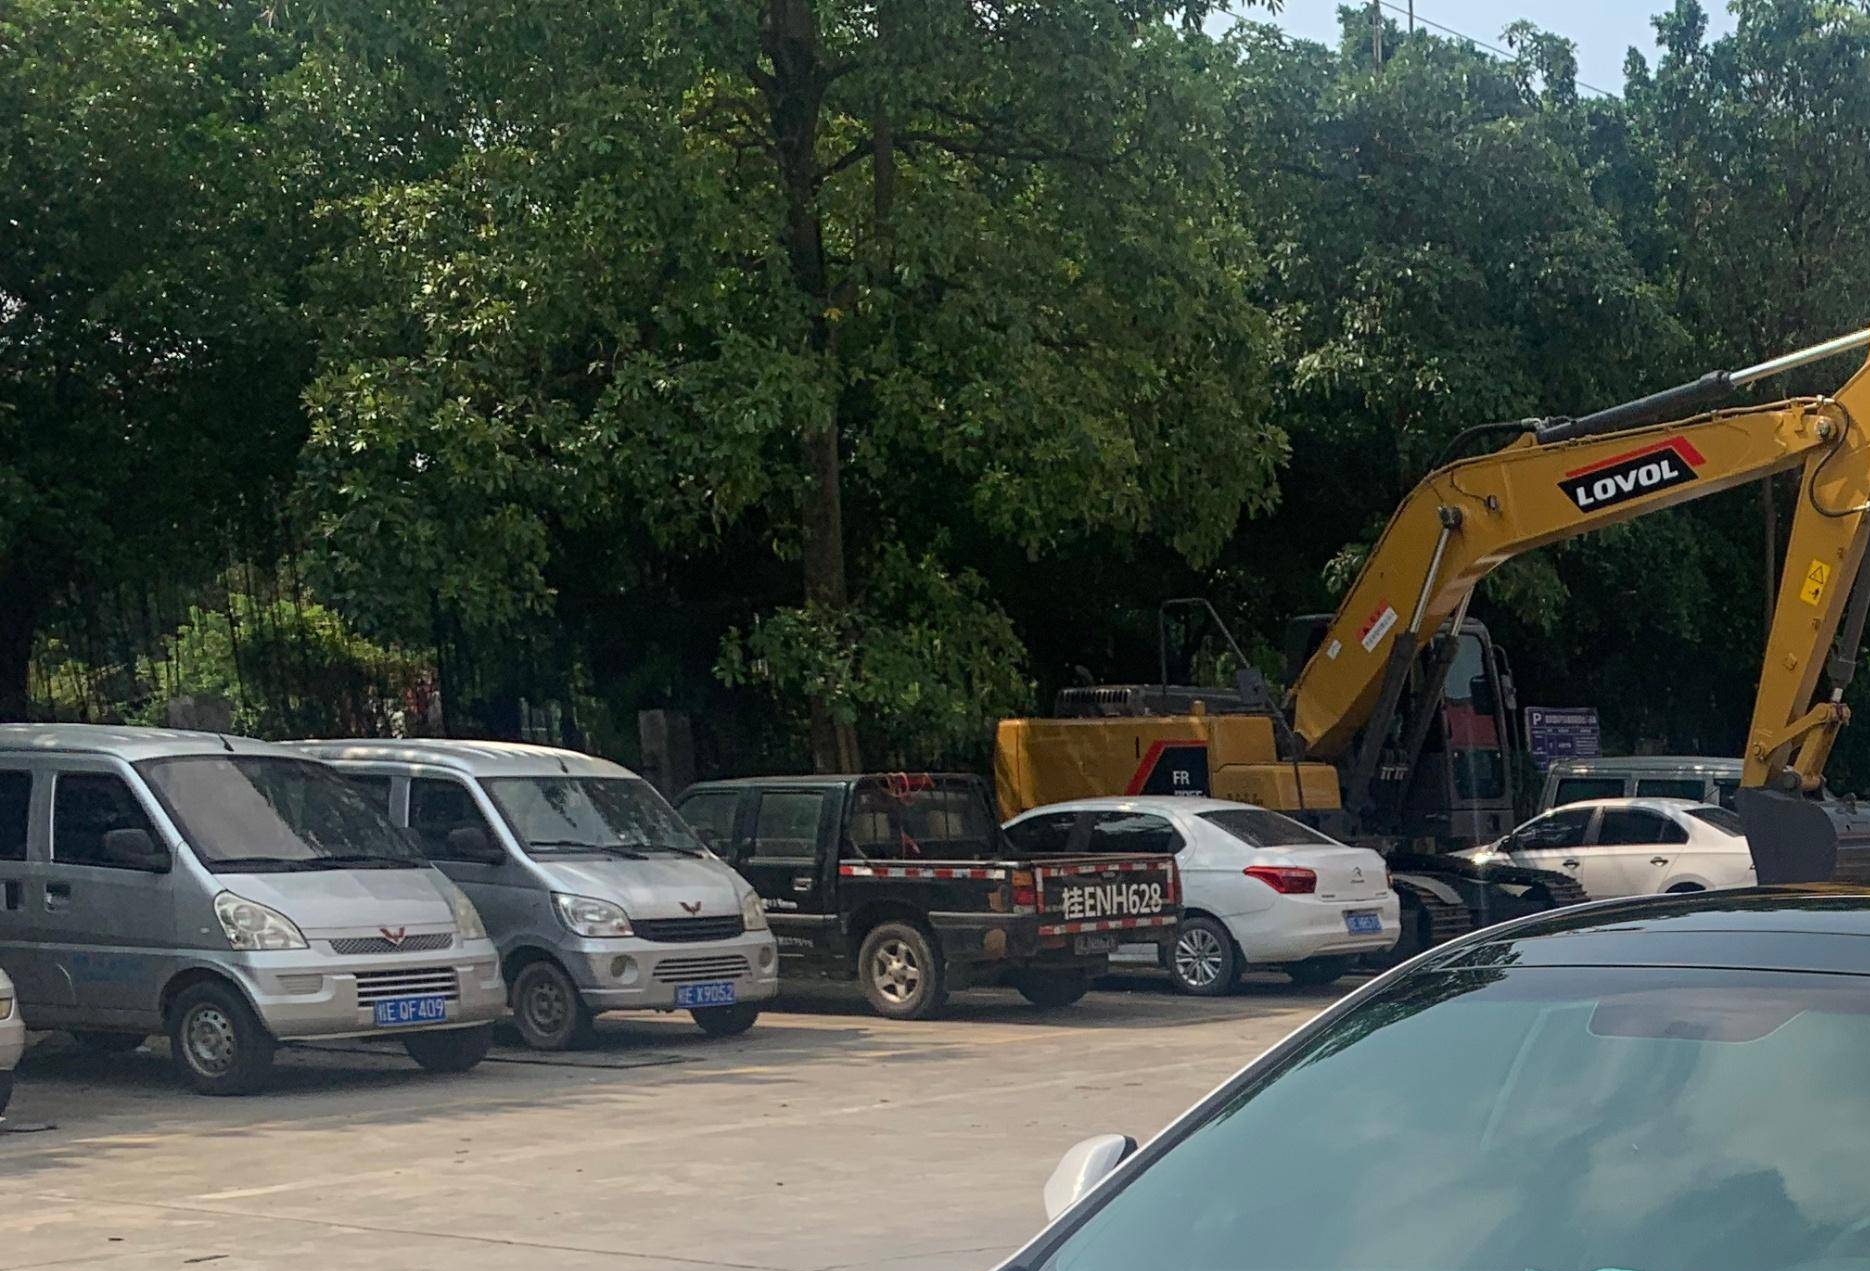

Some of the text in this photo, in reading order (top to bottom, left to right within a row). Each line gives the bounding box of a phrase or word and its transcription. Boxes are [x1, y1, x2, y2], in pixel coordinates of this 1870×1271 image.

[1576, 460, 1679, 506] LOVOL
[1173, 771, 1190, 785] FR
[1062, 883, 1162, 920] 桂ENH628
